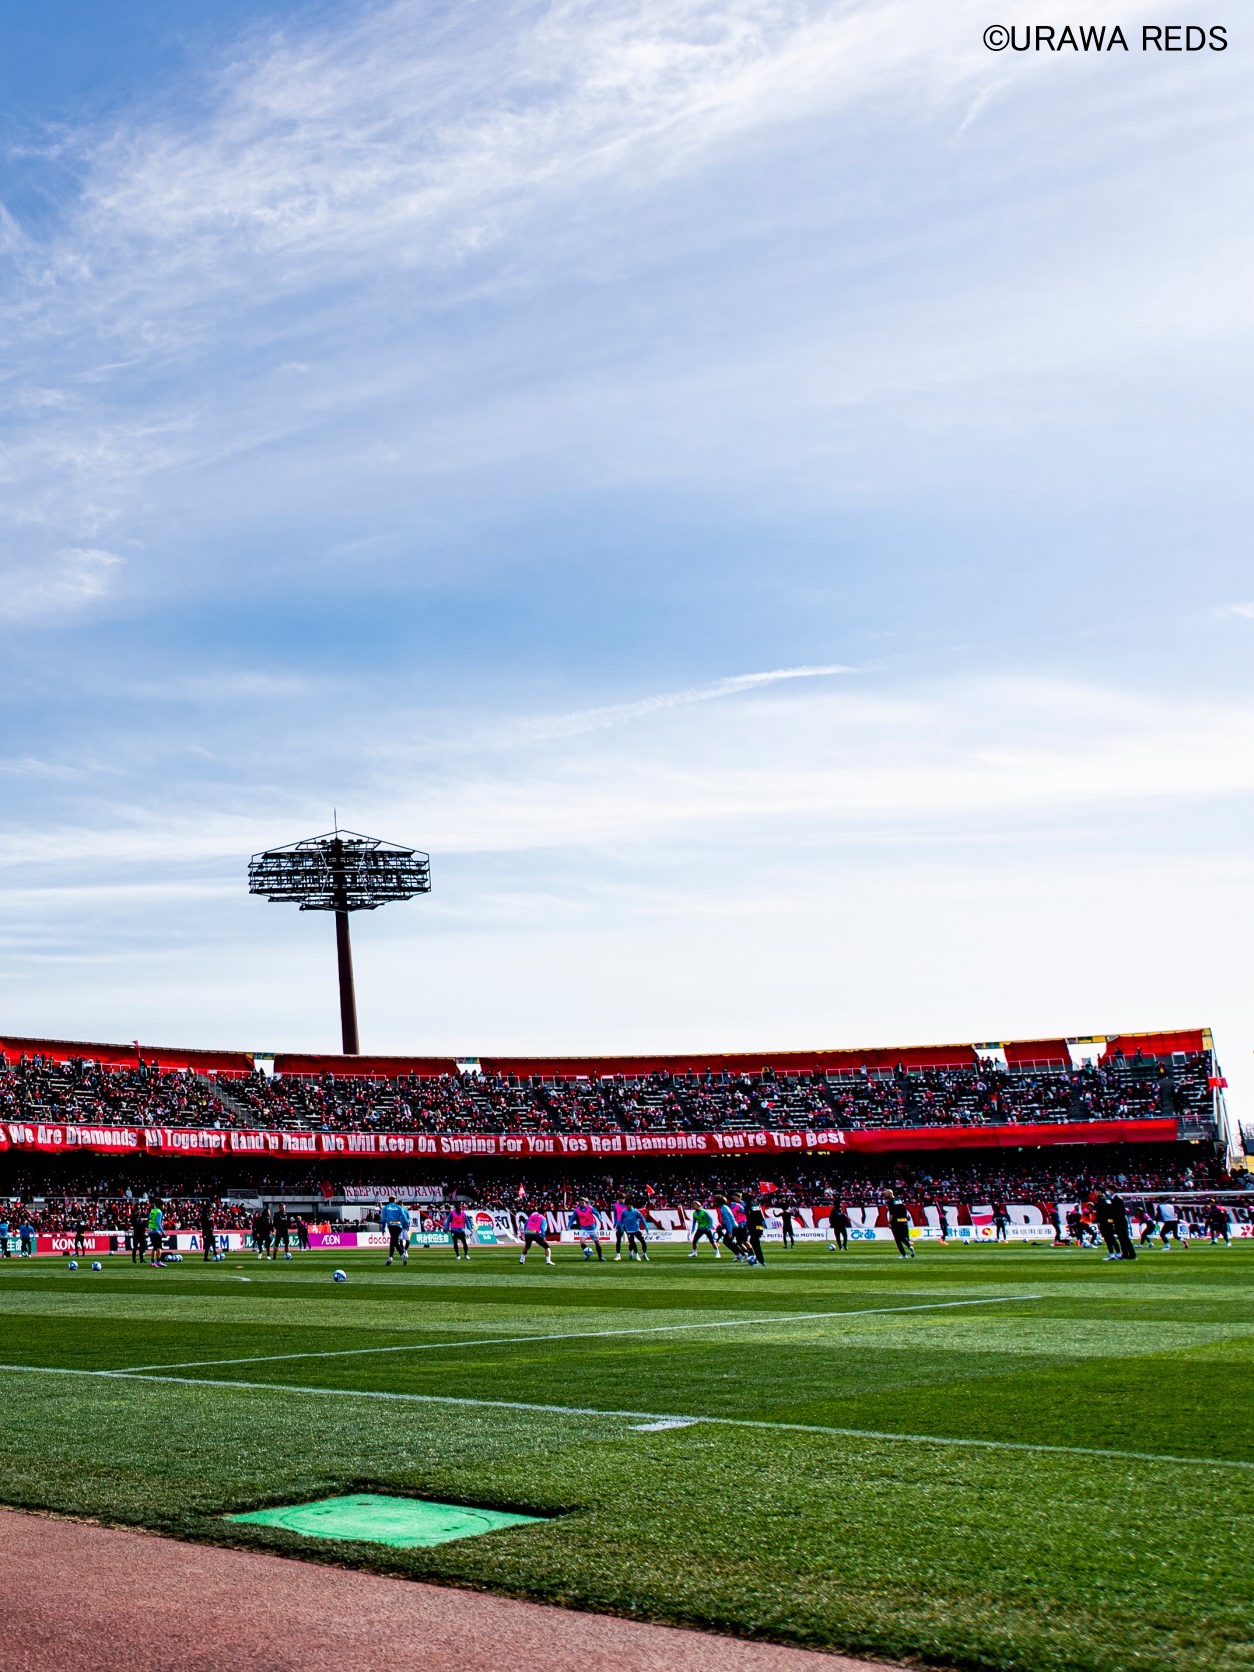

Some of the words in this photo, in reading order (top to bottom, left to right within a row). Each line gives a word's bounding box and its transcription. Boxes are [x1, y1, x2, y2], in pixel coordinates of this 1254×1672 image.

[9, 1124, 34, 1144] We
[37, 1125, 62, 1144] Are
[66, 1126, 137, 1147] Diamonds
[164, 1130, 226, 1150] Together
[230, 1132, 264, 1150] Hand
[282, 1134, 316, 1151] Hand
[321, 1134, 344, 1151] We
[348, 1134, 376, 1152] Will
[379, 1135, 413, 1153] Keep
[418, 1136, 437, 1152] On
[441, 1136, 496, 1153] Singing
[499, 1136, 522, 1152] For
[527, 1136, 554, 1152] You
[560, 1136, 588, 1152] Yes
[591, 1136, 622, 1151] Red
[626, 1134, 707, 1150] Diamonds
[712, 1132, 767, 1149] You're
[770, 1132, 802, 1147] The
[806, 1131, 846, 1147] Best
[345, 1186, 372, 1197] KEEP
[373, 1186, 405, 1197] GOING
[407, 1186, 443, 1197] URAWA
[190, 1235, 229, 1249] AiEM
[416, 1234, 449, 1244] 明治安田生命
